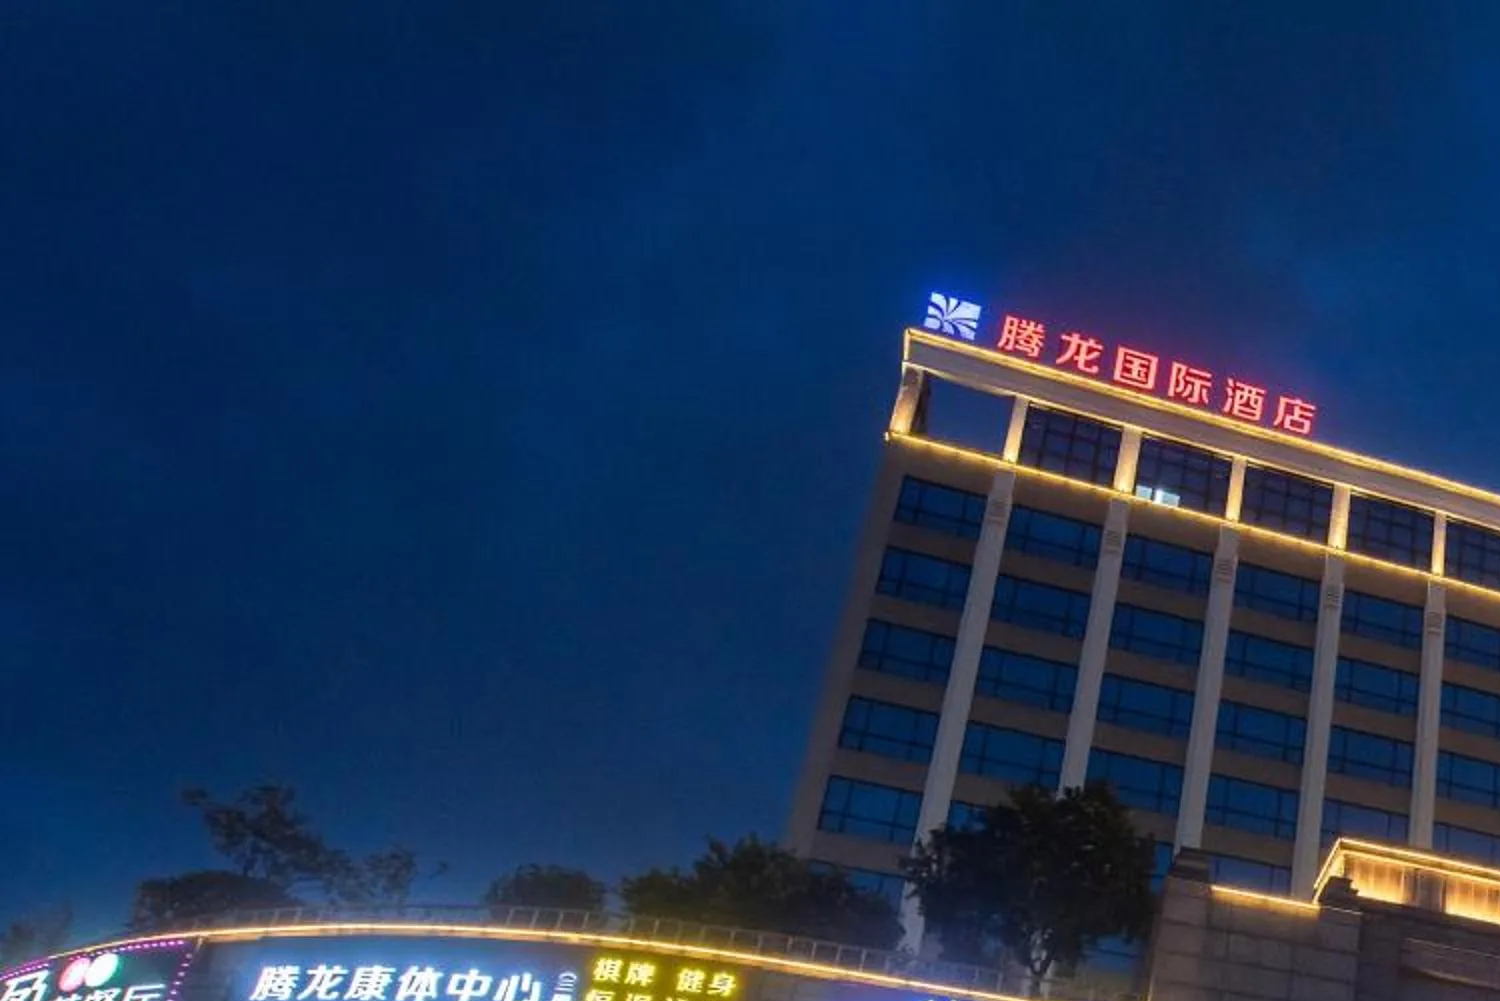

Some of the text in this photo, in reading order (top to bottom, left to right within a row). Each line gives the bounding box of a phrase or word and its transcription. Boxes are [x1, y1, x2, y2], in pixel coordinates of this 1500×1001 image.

[997, 315, 1316, 435] 腾龙国际酒店
[676, 968, 737, 997] 健身
